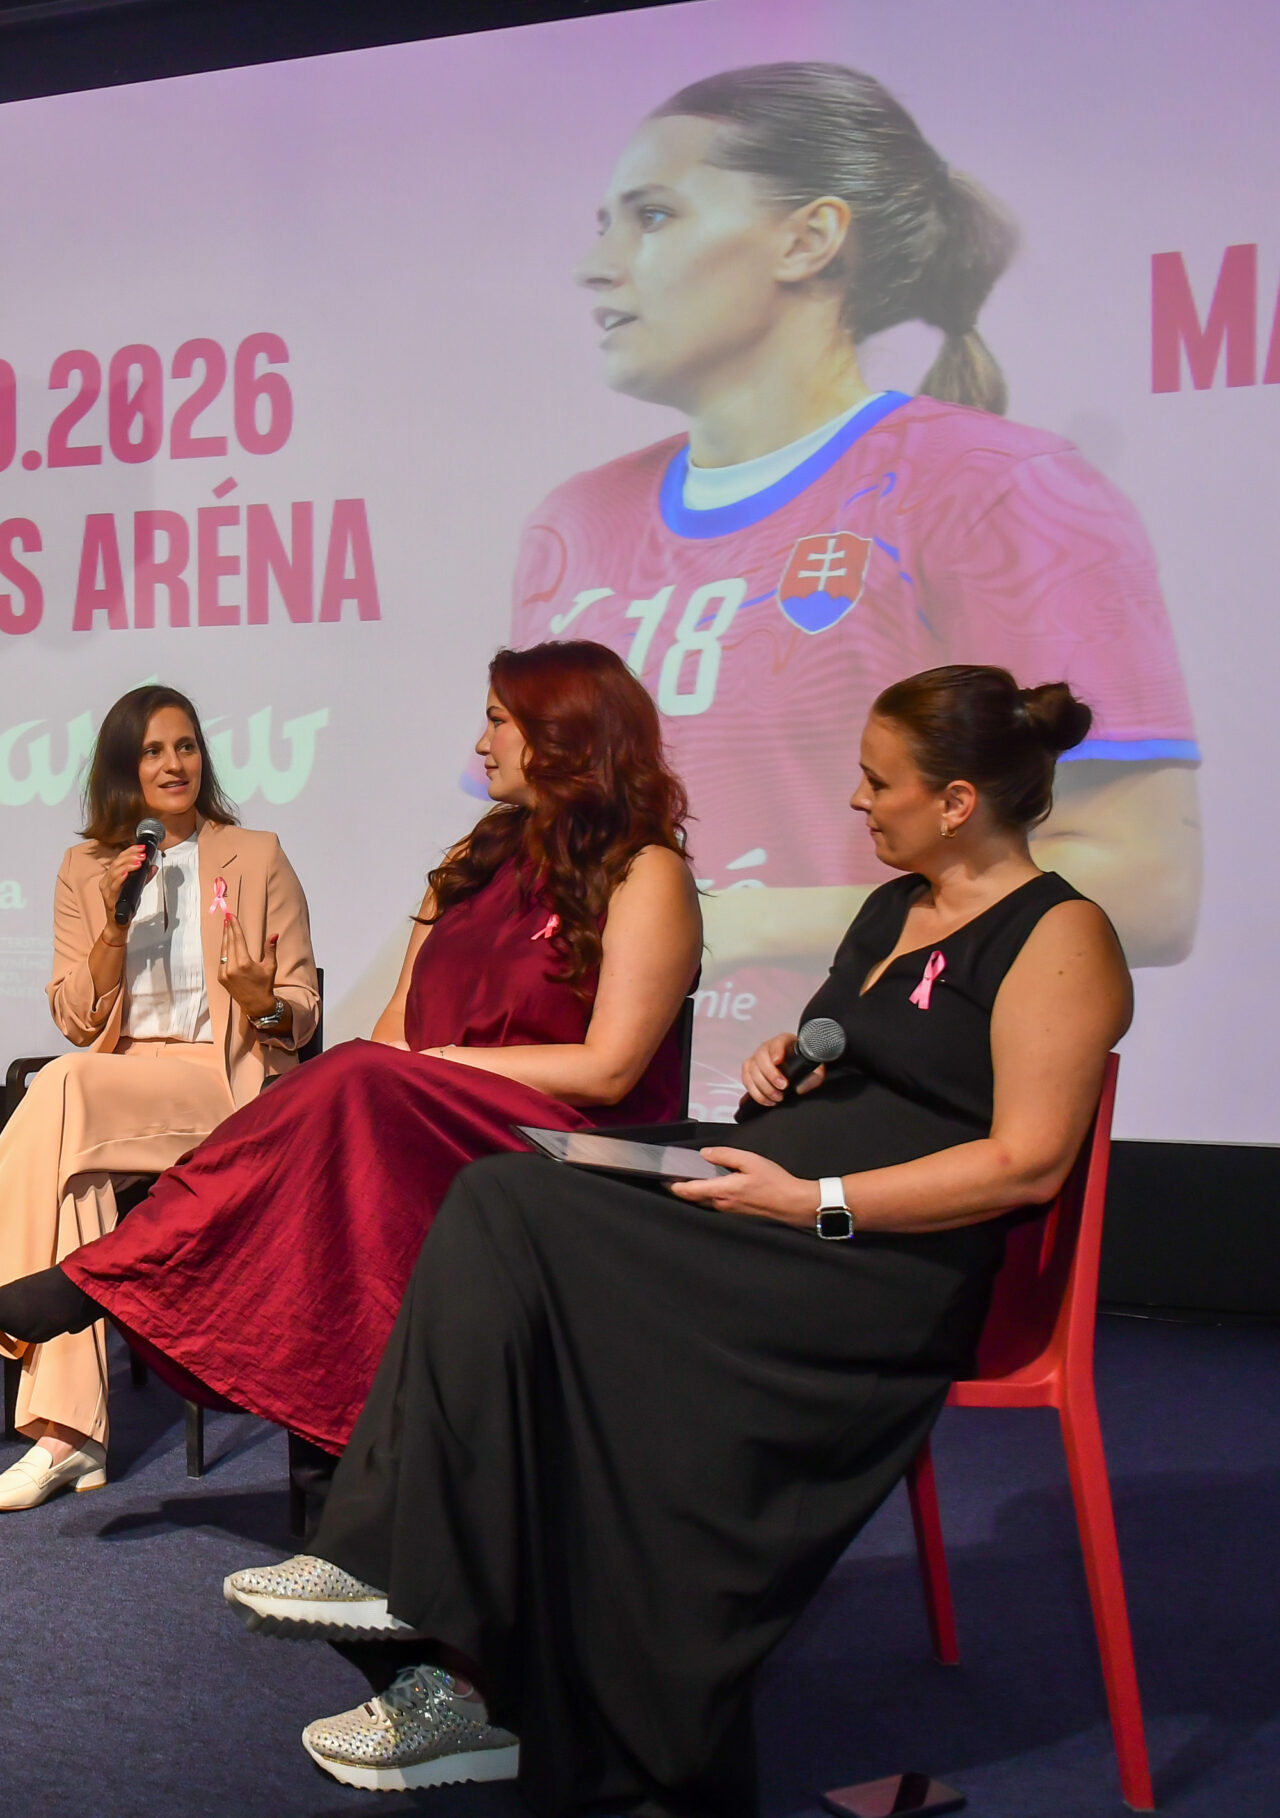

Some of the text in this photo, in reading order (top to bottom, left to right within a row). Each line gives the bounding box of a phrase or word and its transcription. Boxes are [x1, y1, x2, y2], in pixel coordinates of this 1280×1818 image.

[1150, 242, 1280, 394] M
[71, 475, 382, 632] ARÉNA
[625, 577, 748, 717] 18
